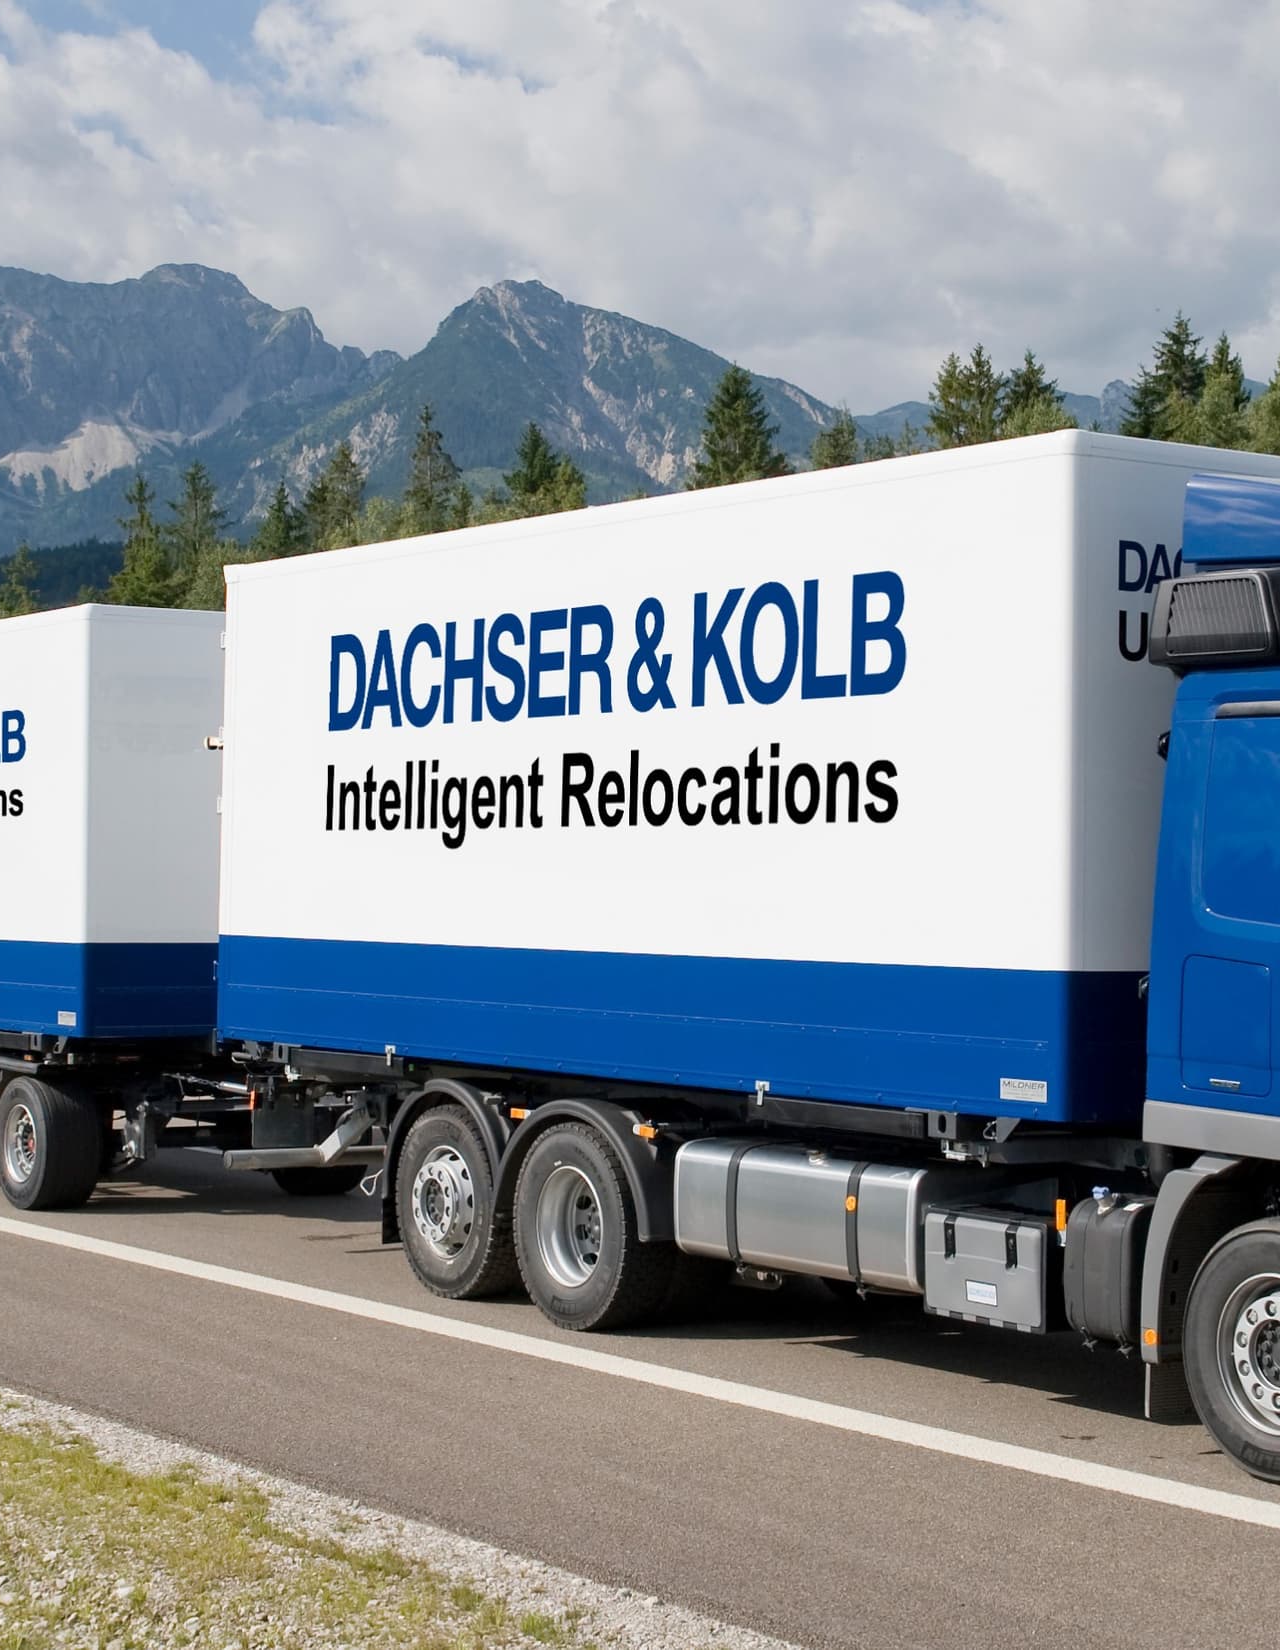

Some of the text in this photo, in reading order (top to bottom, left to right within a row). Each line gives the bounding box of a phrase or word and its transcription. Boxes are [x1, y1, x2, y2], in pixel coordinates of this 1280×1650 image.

[329, 571, 907, 731] DACHSER & KOLB
[326, 743, 899, 850] Intelligent Relocations
